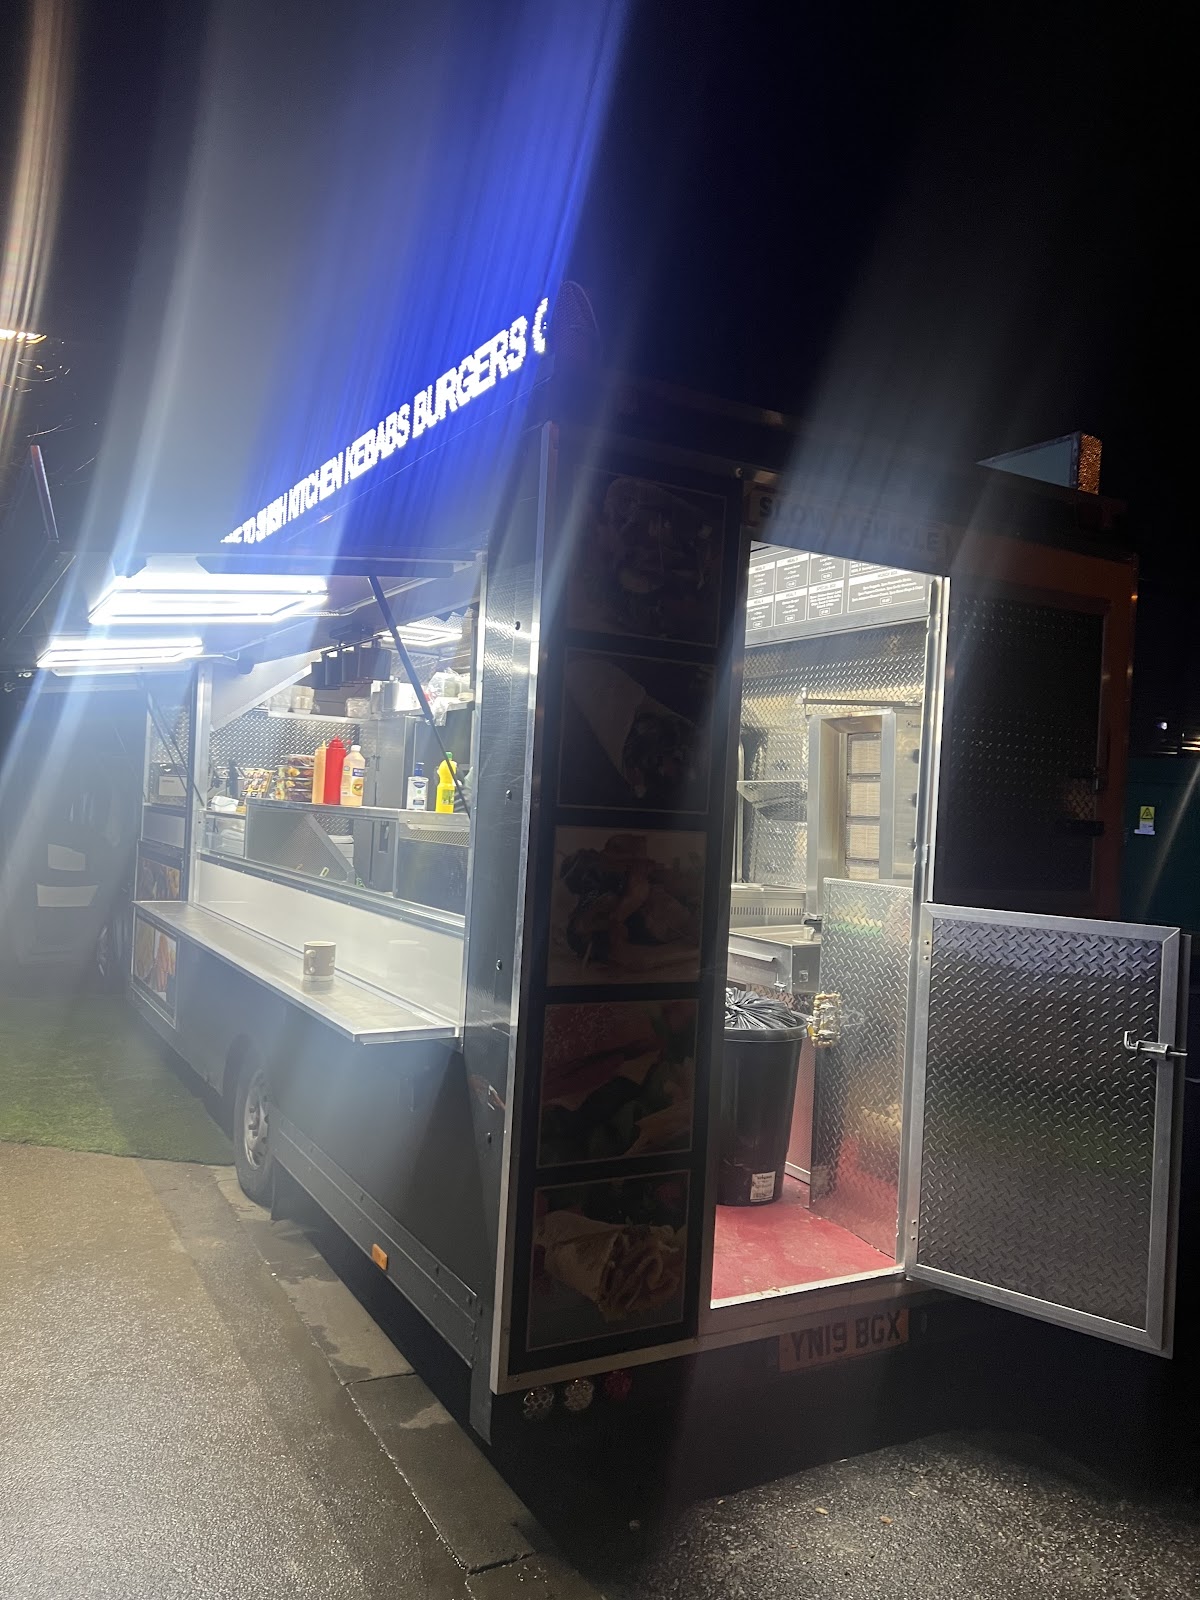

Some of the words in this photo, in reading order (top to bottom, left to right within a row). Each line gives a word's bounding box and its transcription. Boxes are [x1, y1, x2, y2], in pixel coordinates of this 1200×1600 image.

[288, 451, 344, 521] KITCHEN
[344, 403, 410, 484] KEBABS
[412, 315, 528, 438] BURGERS
[791, 1322, 846, 1361] YN19
[856, 1309, 901, 1348] BGX
